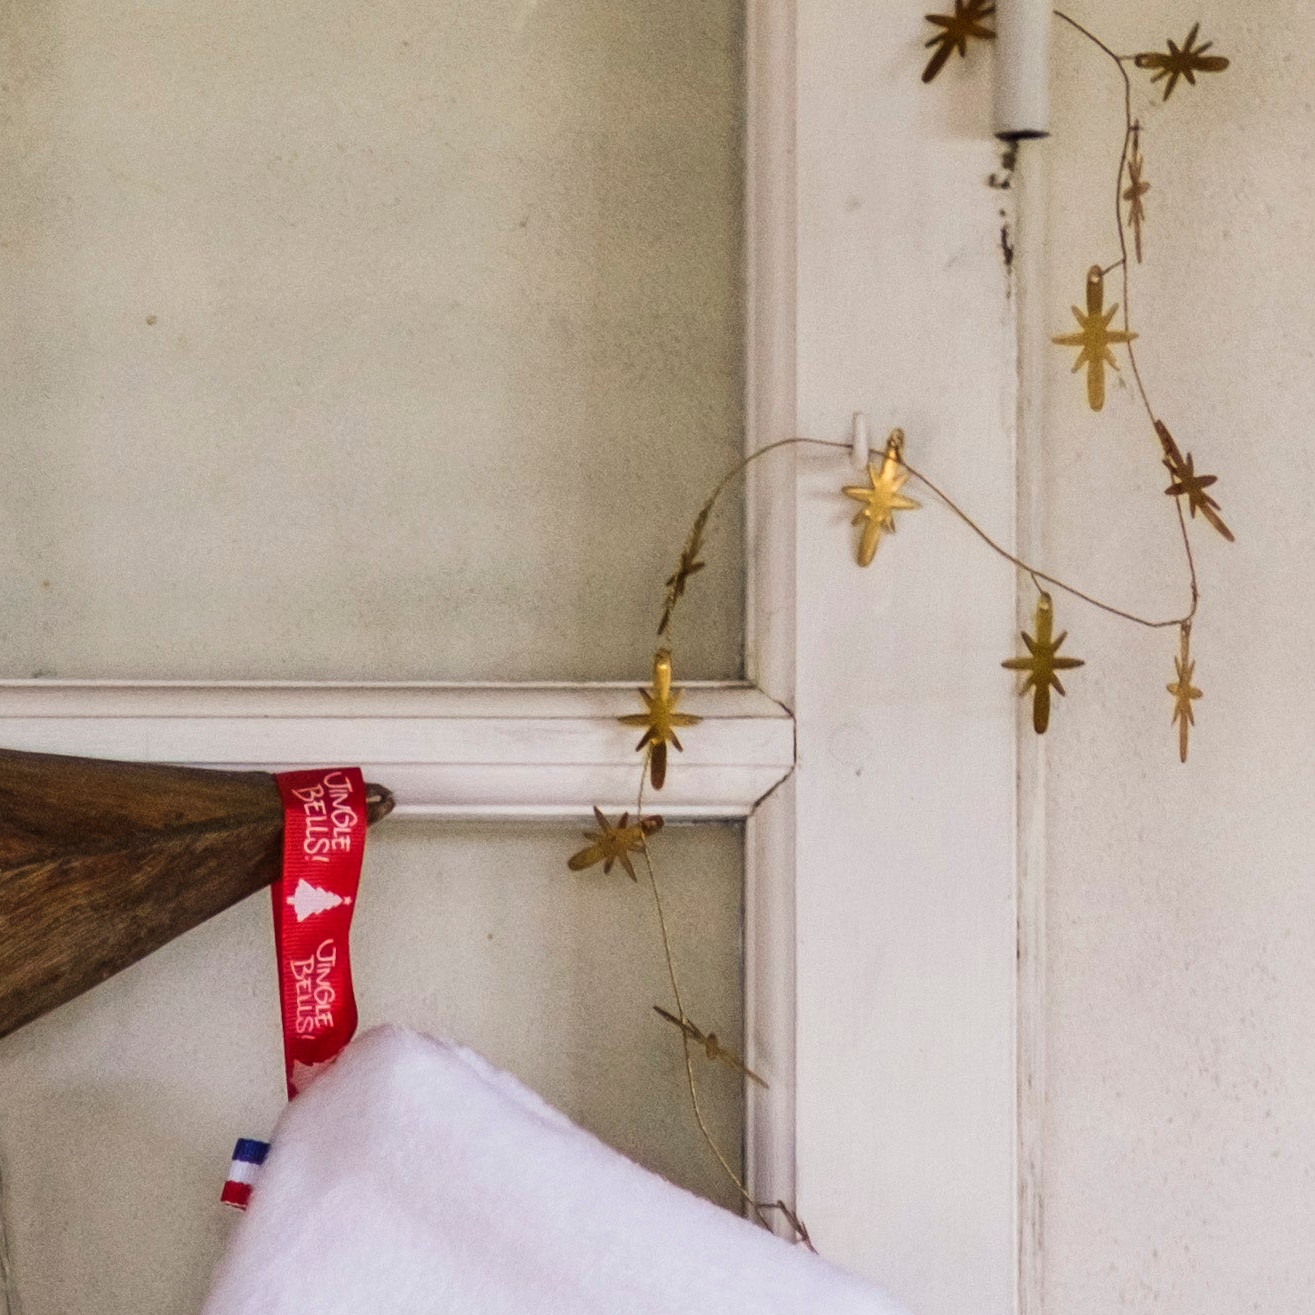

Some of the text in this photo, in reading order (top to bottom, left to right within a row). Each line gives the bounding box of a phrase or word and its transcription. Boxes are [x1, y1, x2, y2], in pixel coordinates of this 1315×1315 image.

[291, 784, 331, 863] BELLS!
[323, 772, 358, 853] JINGLE
[290, 954, 316, 1040] BELLS!
[313, 939, 337, 1029] JINGLE
